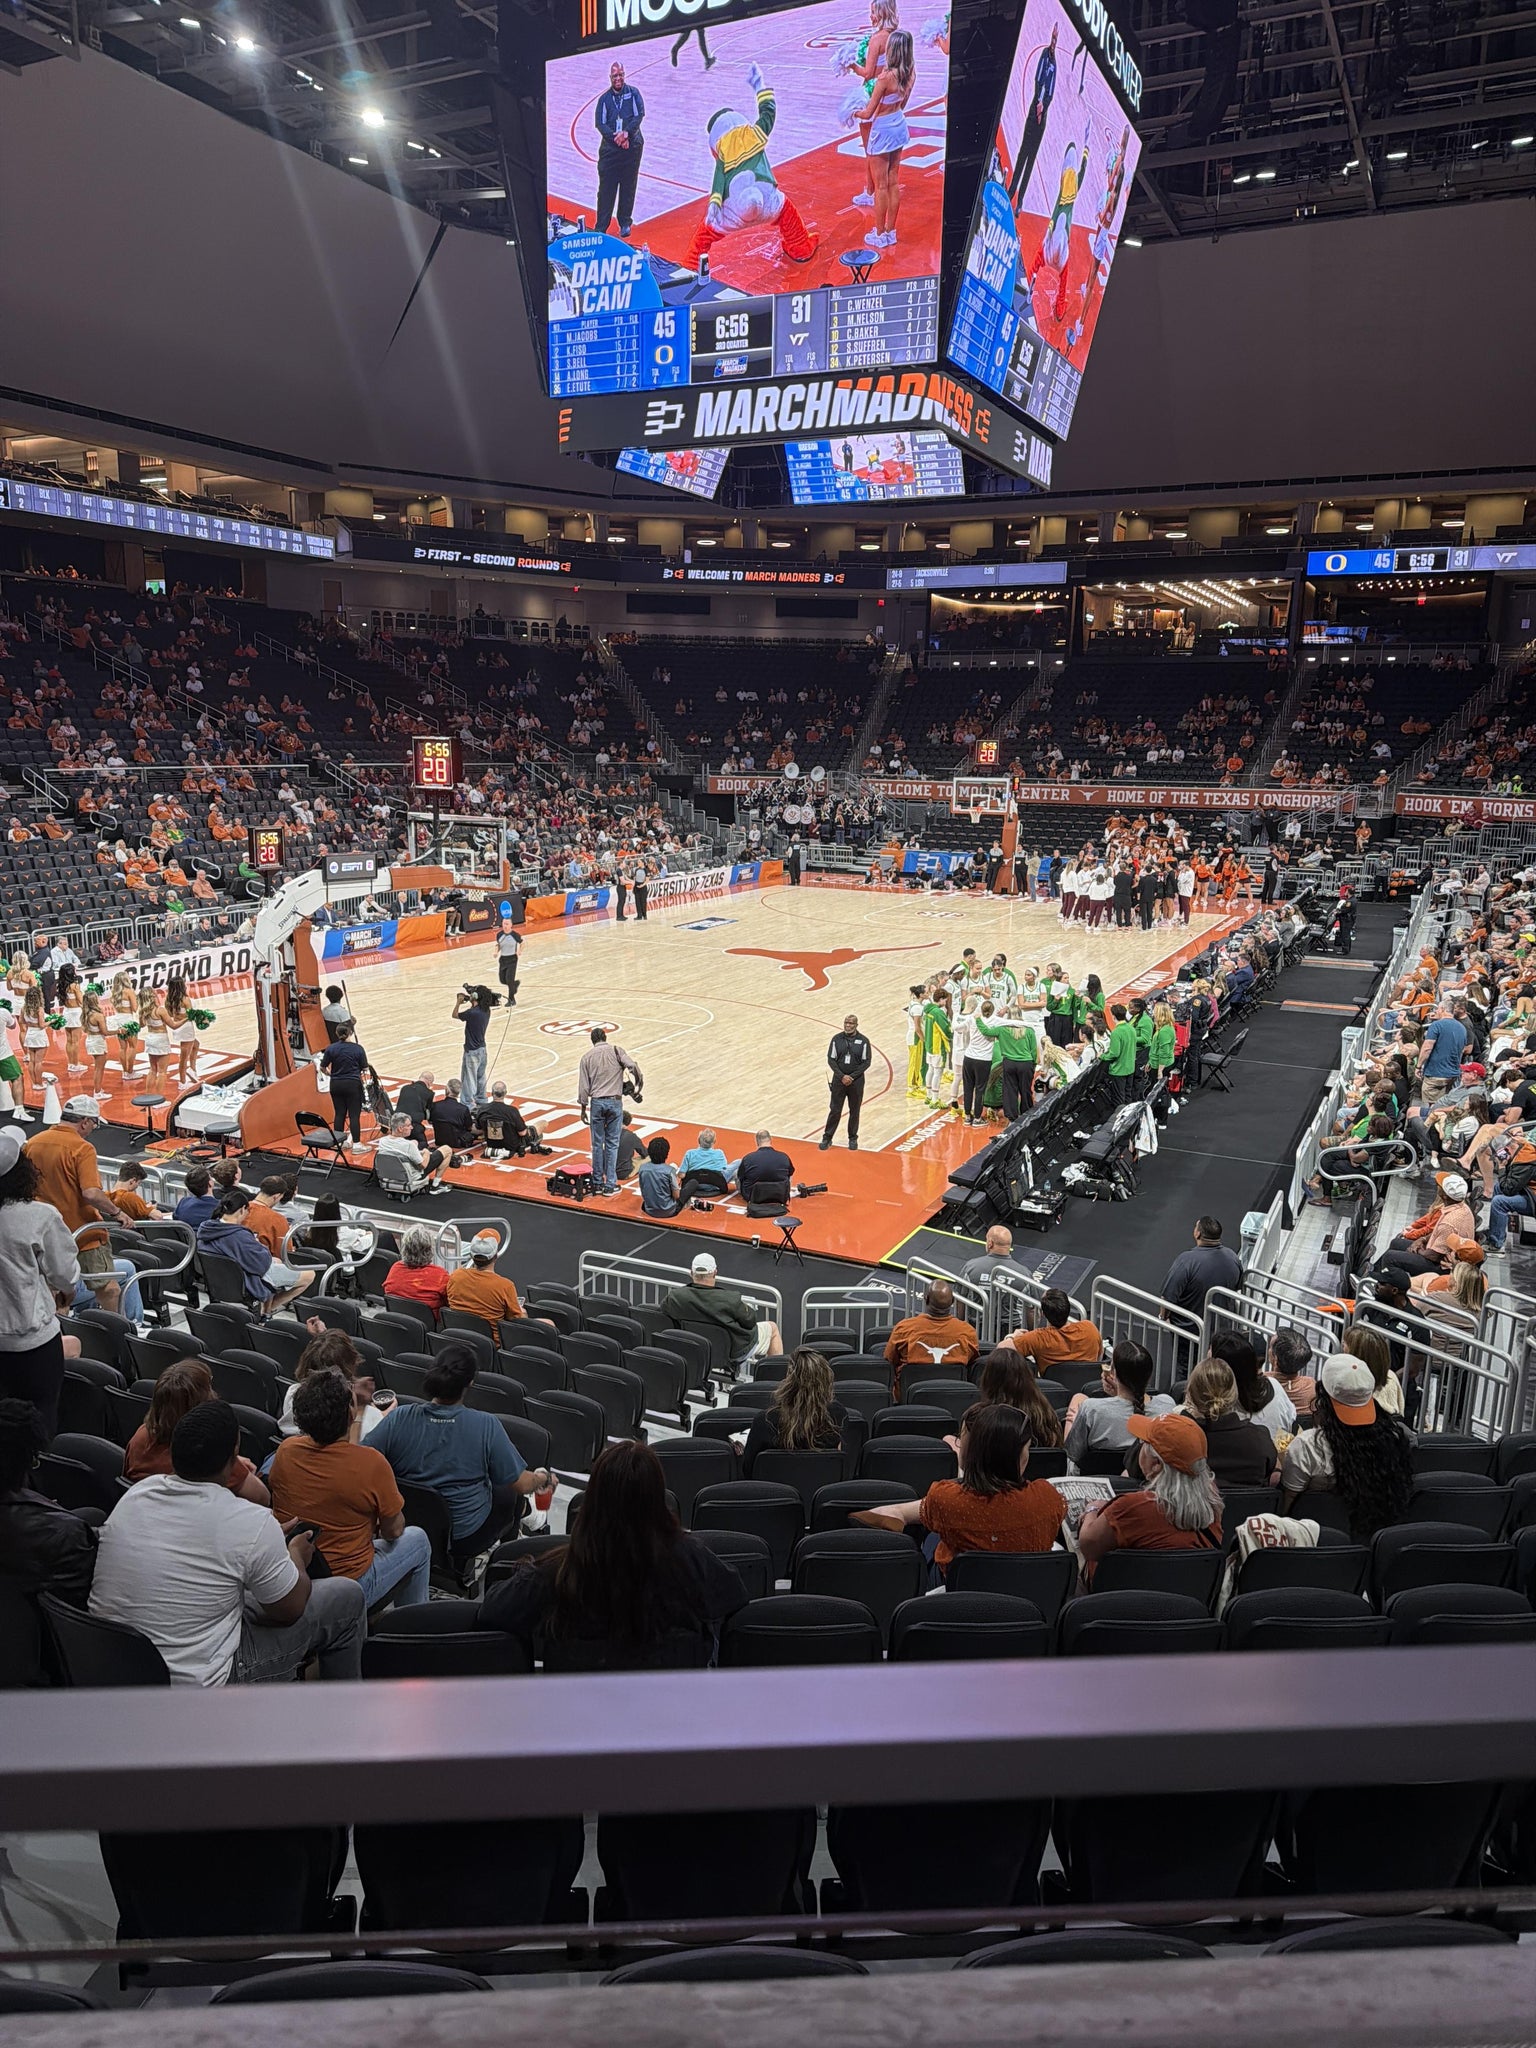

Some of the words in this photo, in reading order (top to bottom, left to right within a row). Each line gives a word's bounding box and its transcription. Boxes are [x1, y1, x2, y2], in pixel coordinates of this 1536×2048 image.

[1107, 22, 1142, 112] CENTER
[562, 235, 603, 250] SAMSUNG
[985, 217, 1018, 270] DANCE
[569, 249, 596, 259] Galaxy
[571, 253, 644, 288] DANCE
[982, 253, 1007, 294] CAM
[865, 285, 887, 295] PLAYER
[906, 281, 917, 292] PTS
[924, 279, 935, 289] FLS
[582, 283, 633, 313] CAM
[847, 297, 883, 311] C.WENZEL
[907, 293, 913, 305] 4
[927, 291, 933, 302] 2
[791, 294, 811, 324] 31
[653, 310, 675, 338] 45
[715, 313, 749, 339] 6:56
[847, 311, 885, 325] M.NELSON
[566, 330, 598, 343] M.JACOBS
[847, 327, 879, 340] C.BAKER
[726, 338, 749, 350] QUARTER
[846, 339, 886, 353] S.SUFFREN
[566, 357, 587, 369] S.BELL
[830, 358, 839, 369] 34
[846, 352, 890, 367] K.PETERSEN
[566, 369, 589, 381] A.LONG
[566, 382, 591, 393] E.ETUTE
[693, 372, 974, 439] MARCHMADNESS
[15, 484, 26, 496] STL
[39, 488, 50, 500] BLK
[82, 496, 93, 507] AST
[841, 488, 851, 500] 45
[903, 484, 913, 496] 31
[19, 498, 24, 509] 2
[428, 549, 461, 562] FIRST
[473, 553, 516, 567] SECOND
[517, 557, 560, 571] ROUNDS
[1374, 553, 1391, 568] 45
[1409, 553, 1435, 567] 6:56
[1454, 550, 1470, 566] 31
[1495, 552, 1519, 564] VT
[688, 569, 730, 581] WELCOME
[732, 570, 744, 581] TO
[745, 571, 776, 582] MARCH
[778, 572, 821, 583] MADNESS
[915, 568, 949, 577] JACKSONVILLE
[425, 742, 450, 757] 6:56
[980, 749, 995, 762] 28
[422, 757, 447, 783] 28
[717, 779, 751, 791] HOOK
[937, 785, 952, 797] TO
[1013, 787, 1070, 801] ENTER
[1107, 790, 1145, 803] HOME
[1149, 791, 1167, 804] OF
[1171, 792, 1199, 805] THE
[1204, 792, 1250, 806] TEXAS
[1404, 797, 1443, 813] HOOK
[1482, 802, 1534, 817] HORNS
[260, 846, 276, 862] 28
[647, 879, 688, 898] IVERSITY
[690, 877, 700, 891] OF
[700, 872, 725, 889] TEXAS
[351, 929, 372, 941] MARCH
[354, 937, 382, 950] MADNESS
[125, 954, 211, 992] SECOND
